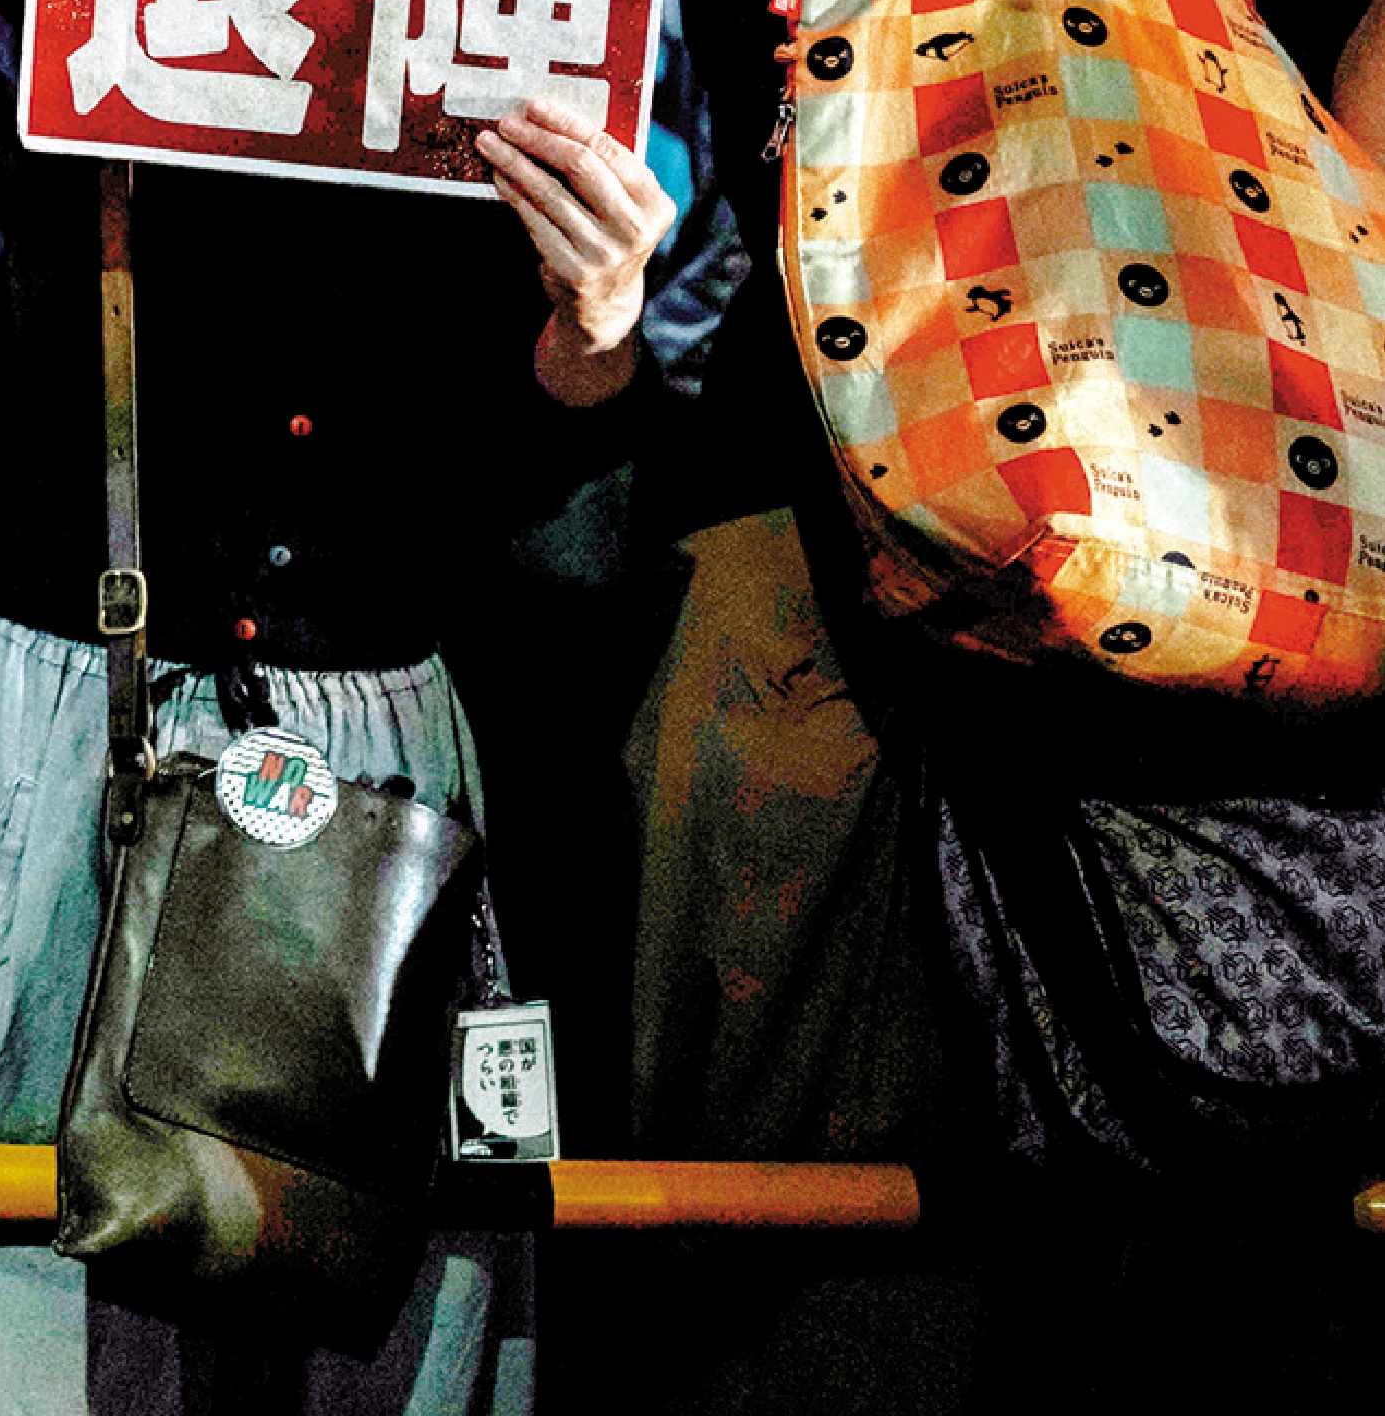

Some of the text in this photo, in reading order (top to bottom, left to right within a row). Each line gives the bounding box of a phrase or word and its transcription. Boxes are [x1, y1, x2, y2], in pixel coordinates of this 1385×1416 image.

[257, 750, 309, 788] NO
[242, 772, 314, 820] WAR
[475, 1041, 496, 1092] つらい
